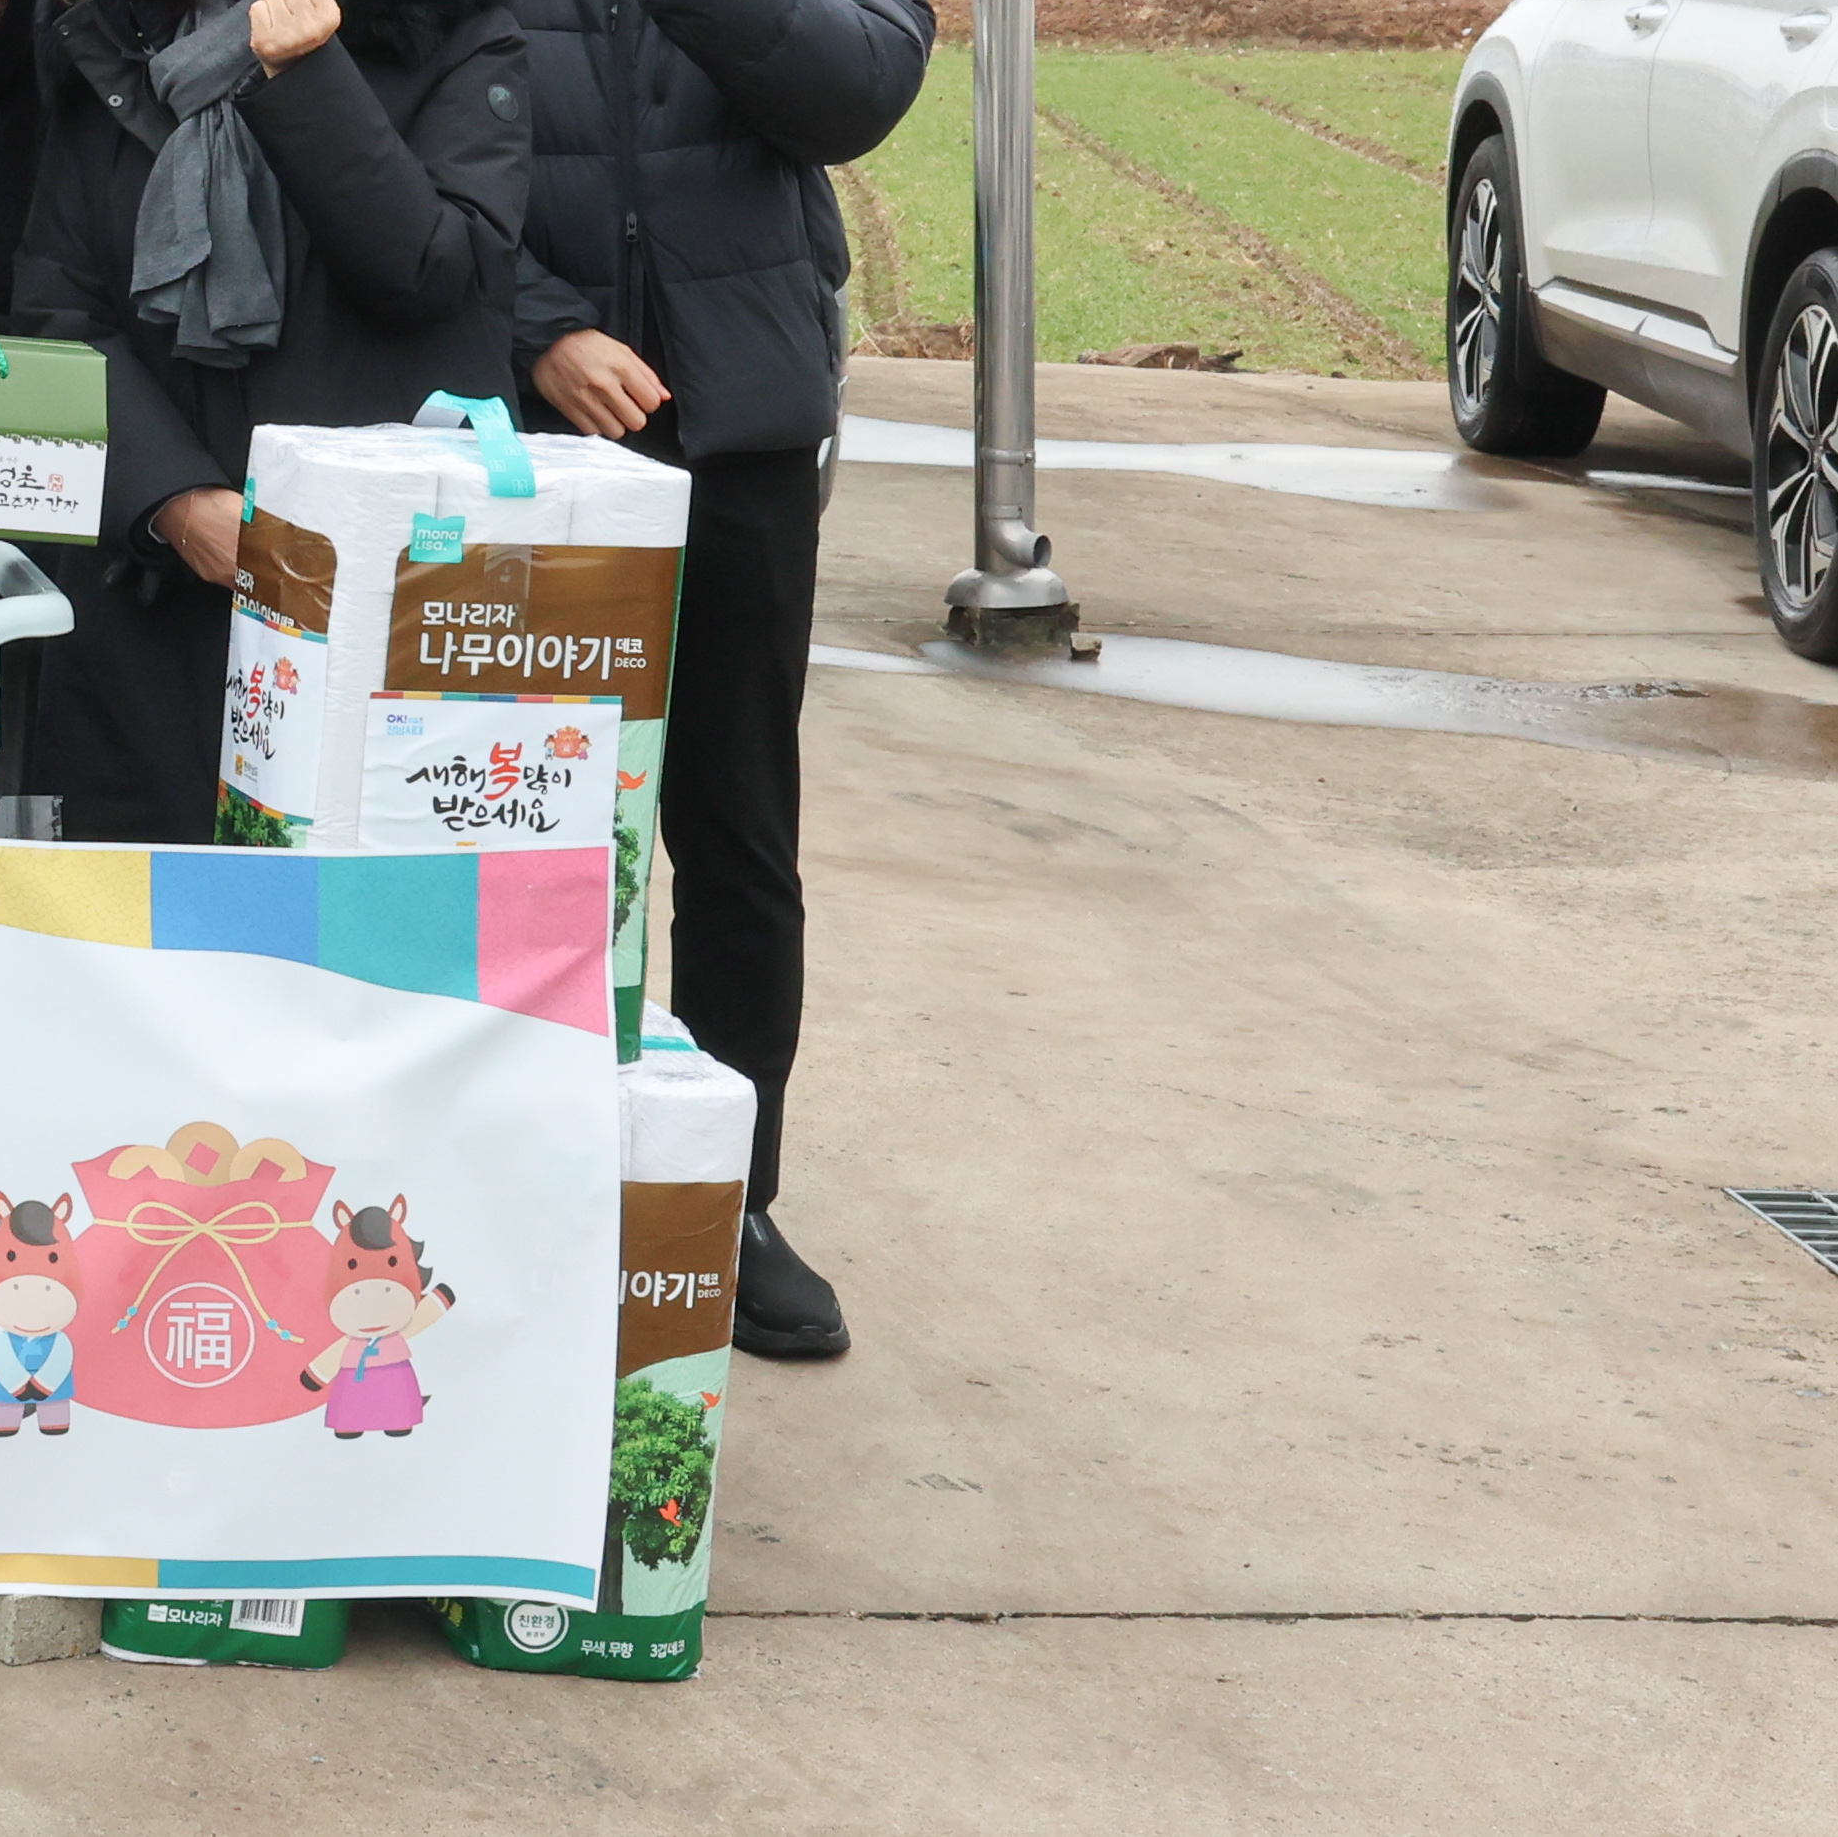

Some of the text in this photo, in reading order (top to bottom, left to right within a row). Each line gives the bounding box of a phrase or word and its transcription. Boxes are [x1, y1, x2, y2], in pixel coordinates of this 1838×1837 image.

[416, 528, 459, 541] mona
[422, 601, 516, 628] 모나리자
[419, 631, 644, 681] 나무이야기 데코
[614, 657, 647, 669] DECO
[433, 794, 560, 833] 받으세요
[698, 1272, 720, 1287] 데코
[697, 1288, 722, 1299] DECO
[165, 1302, 234, 1370] 福
[167, 1608, 223, 1628] 모나리자
[518, 1614, 555, 1629] 친환경
